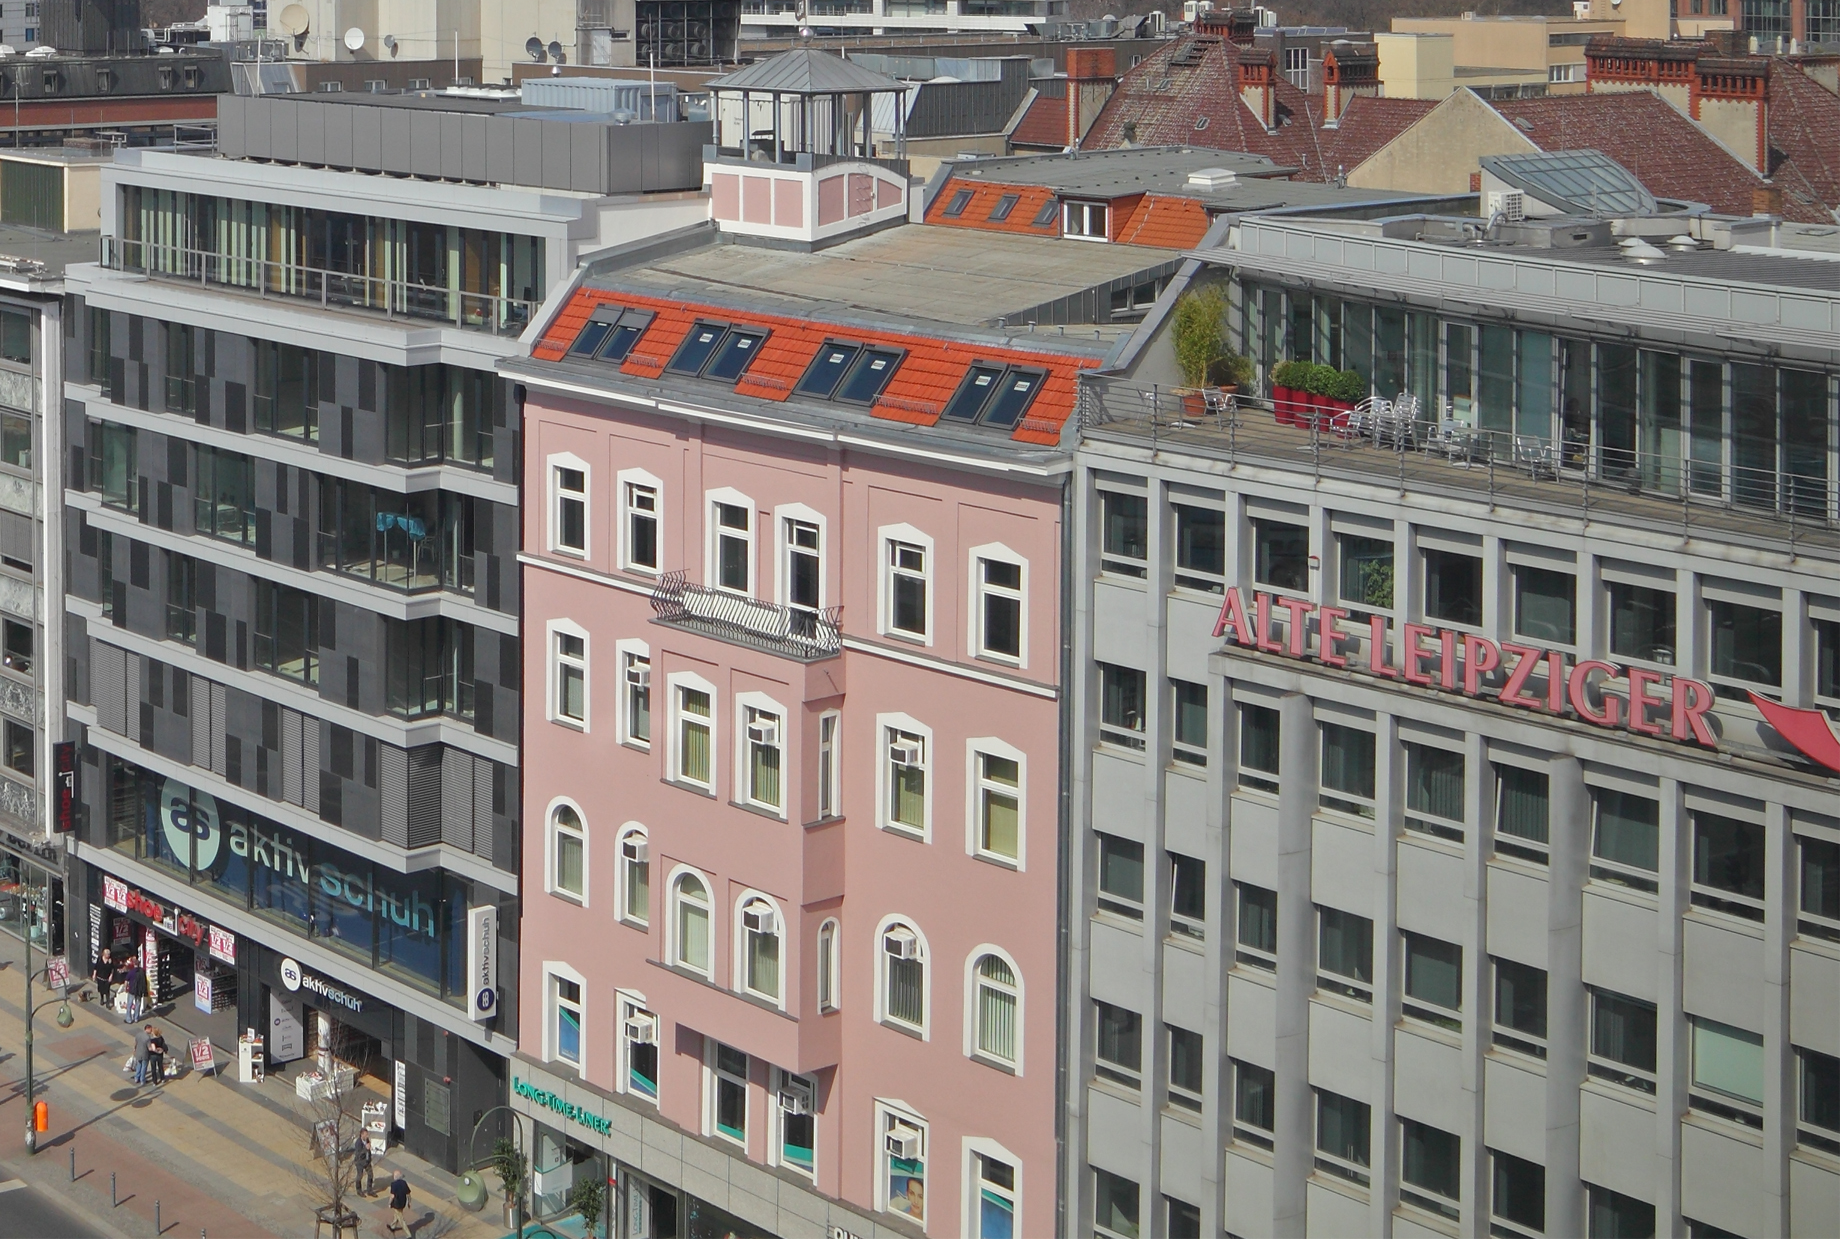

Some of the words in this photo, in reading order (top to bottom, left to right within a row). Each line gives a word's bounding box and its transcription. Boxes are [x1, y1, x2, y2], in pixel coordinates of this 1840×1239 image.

[1212, 586, 1350, 668] ALTE
[1370, 614, 1717, 748] LEIPZIGER
[59, 788, 71, 831] shoe
[127, 889, 163, 922] shoe
[481, 917, 490, 986] aktivschuh
[302, 976, 361, 1012] aktivschuh
[193, 1045, 209, 1057] 1/2
